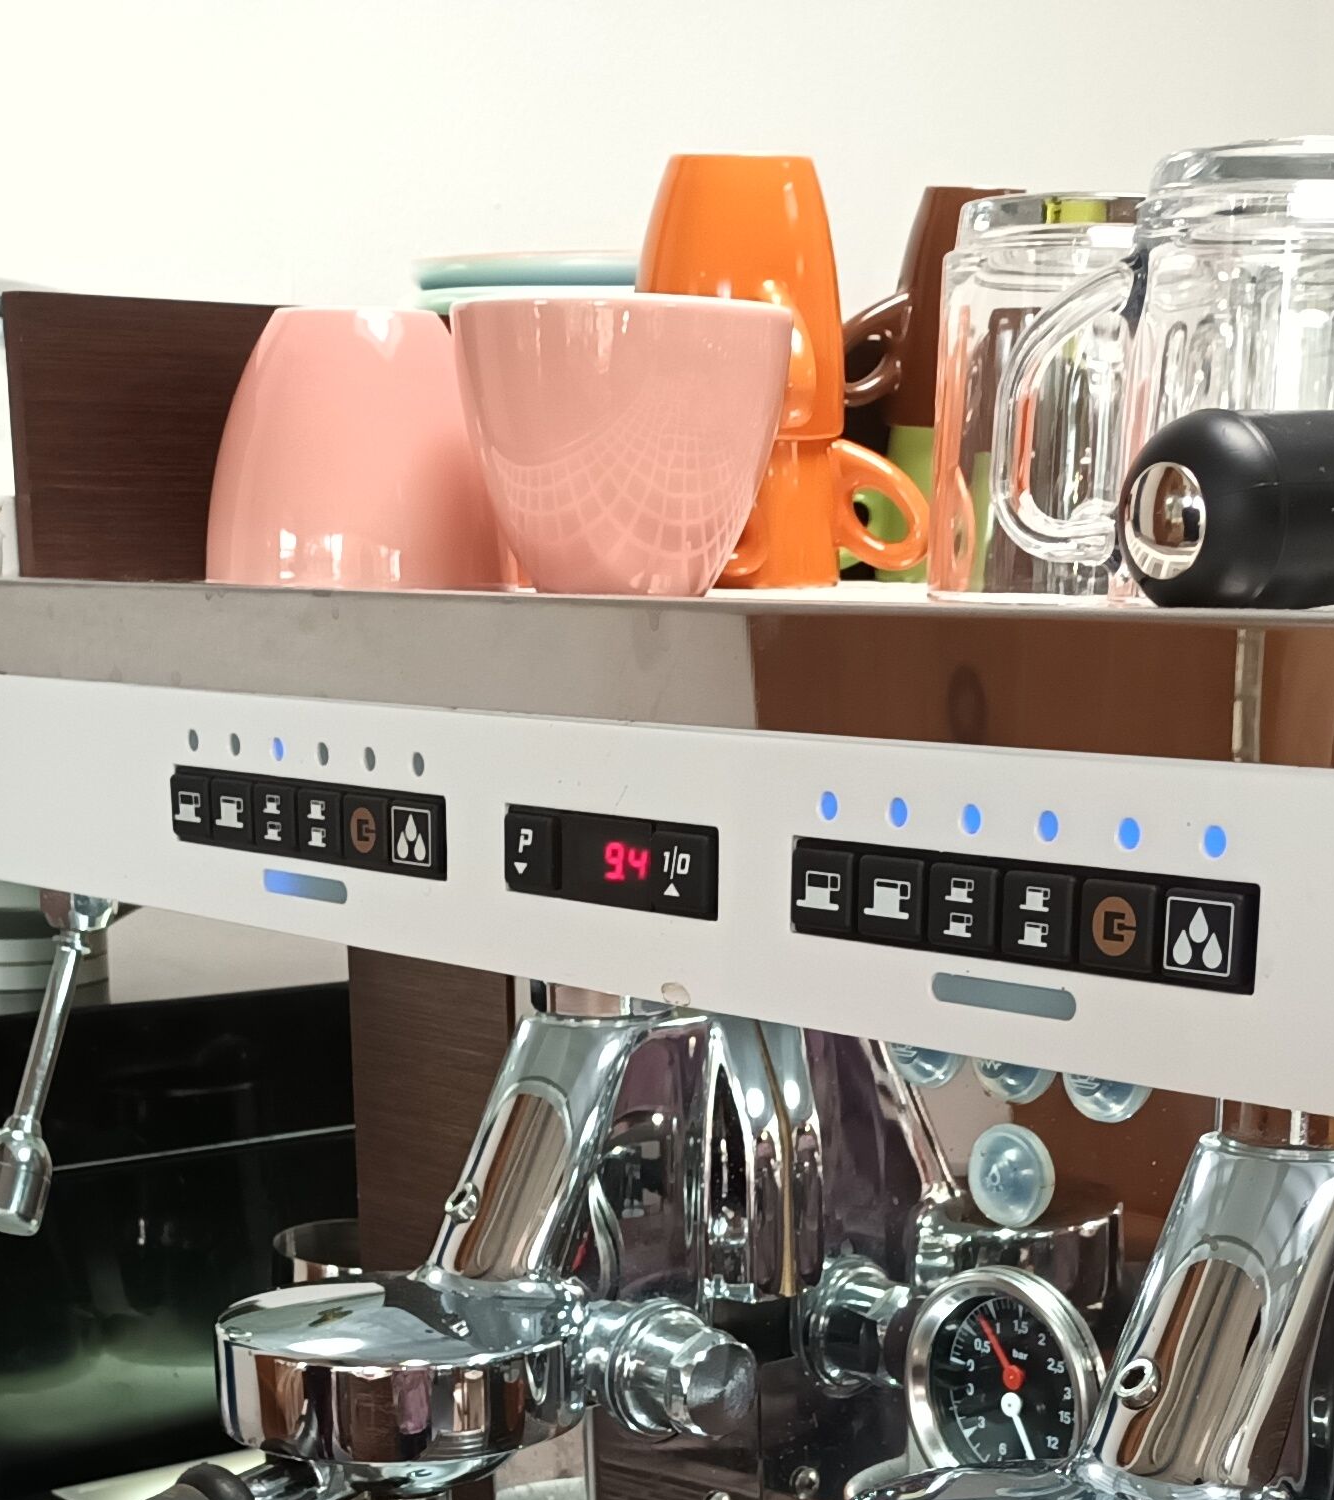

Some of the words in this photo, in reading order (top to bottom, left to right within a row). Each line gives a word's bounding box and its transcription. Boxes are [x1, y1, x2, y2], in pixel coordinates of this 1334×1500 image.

[518, 828, 533, 854] P
[604, 841, 650, 881] 94
[1013, 1319, 1029, 1335] 1,5
[974, 1338, 991, 1354] 0,5
[1037, 1333, 1046, 1346] 2
[1012, 1348, 1028, 1361] bar
[1046, 1357, 1065, 1374] 2,5
[1063, 1386, 1072, 1400] 3
[977, 1415, 986, 1429] 3
[1058, 1410, 1071, 1425] 15
[998, 1442, 1007, 1456] 6
[1046, 1435, 1059, 1450] 12
